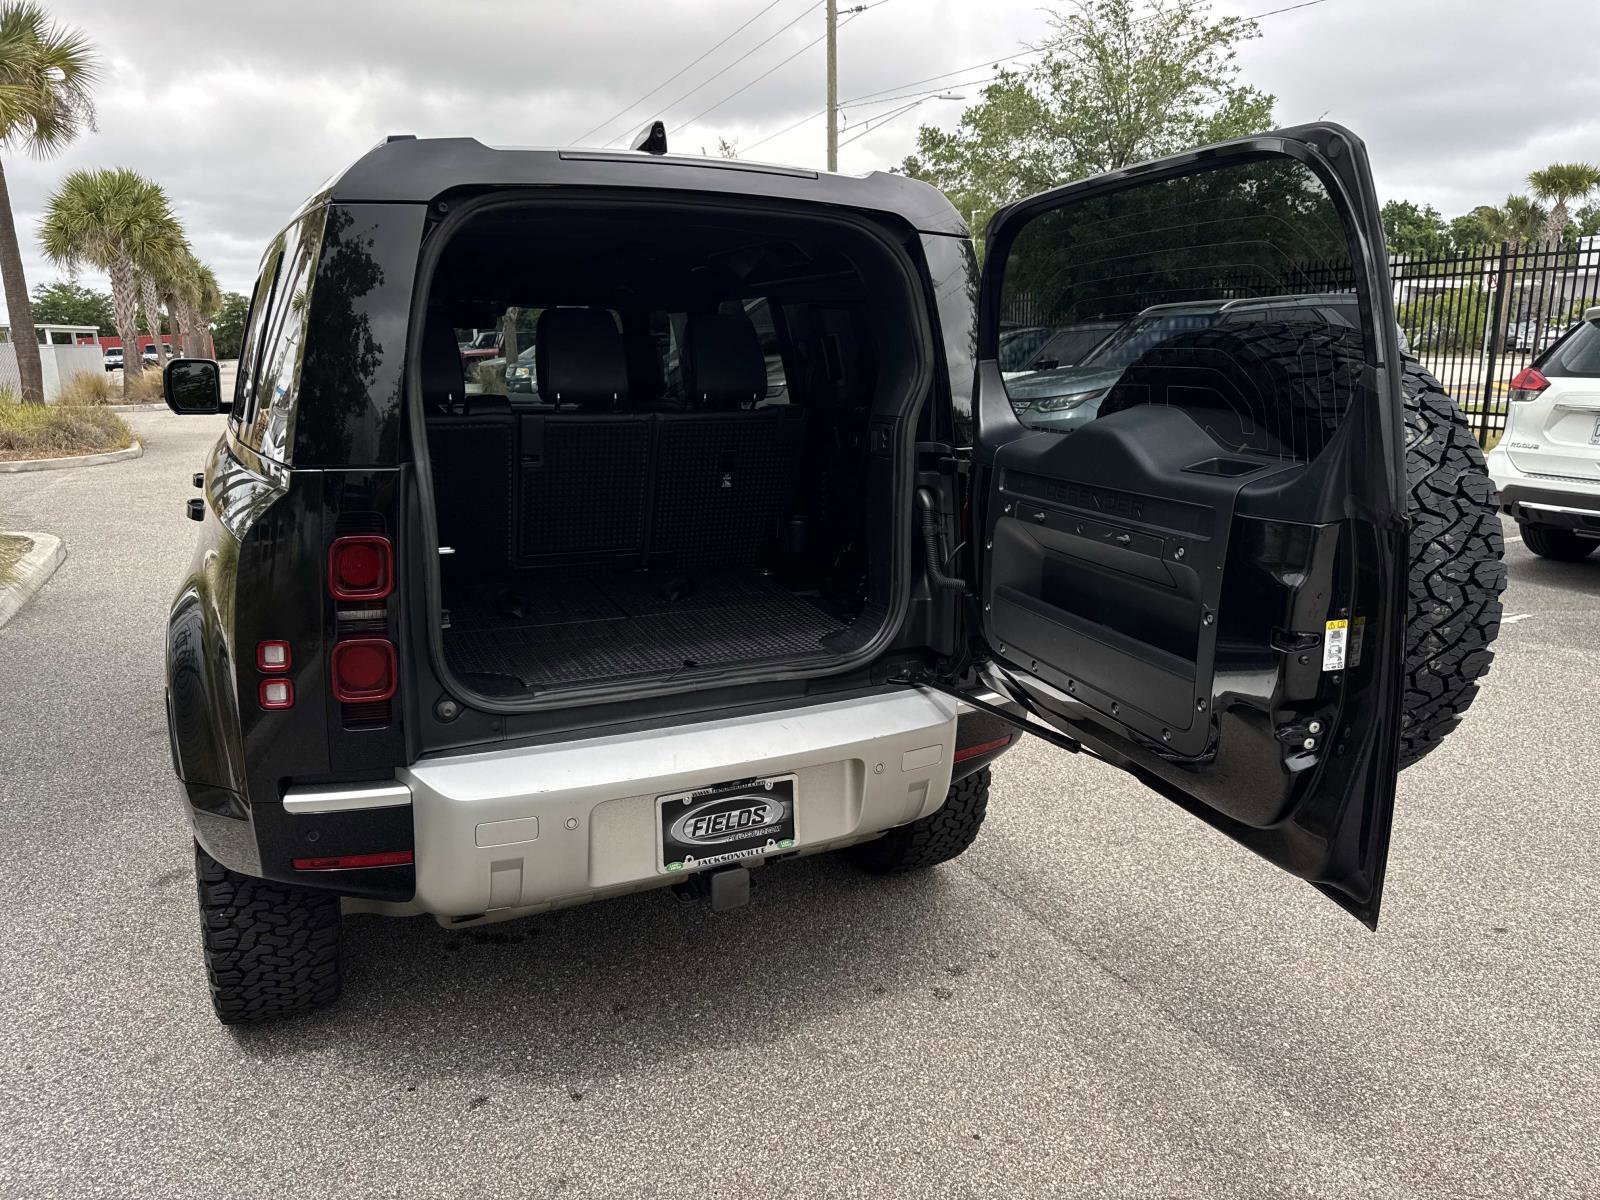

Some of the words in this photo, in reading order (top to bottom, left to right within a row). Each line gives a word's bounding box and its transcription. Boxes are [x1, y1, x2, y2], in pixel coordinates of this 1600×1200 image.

[1042, 482, 1144, 521] DEFENDER
[691, 806, 767, 836] FIELDS
[698, 848, 766, 866] JACKSONVILLE
